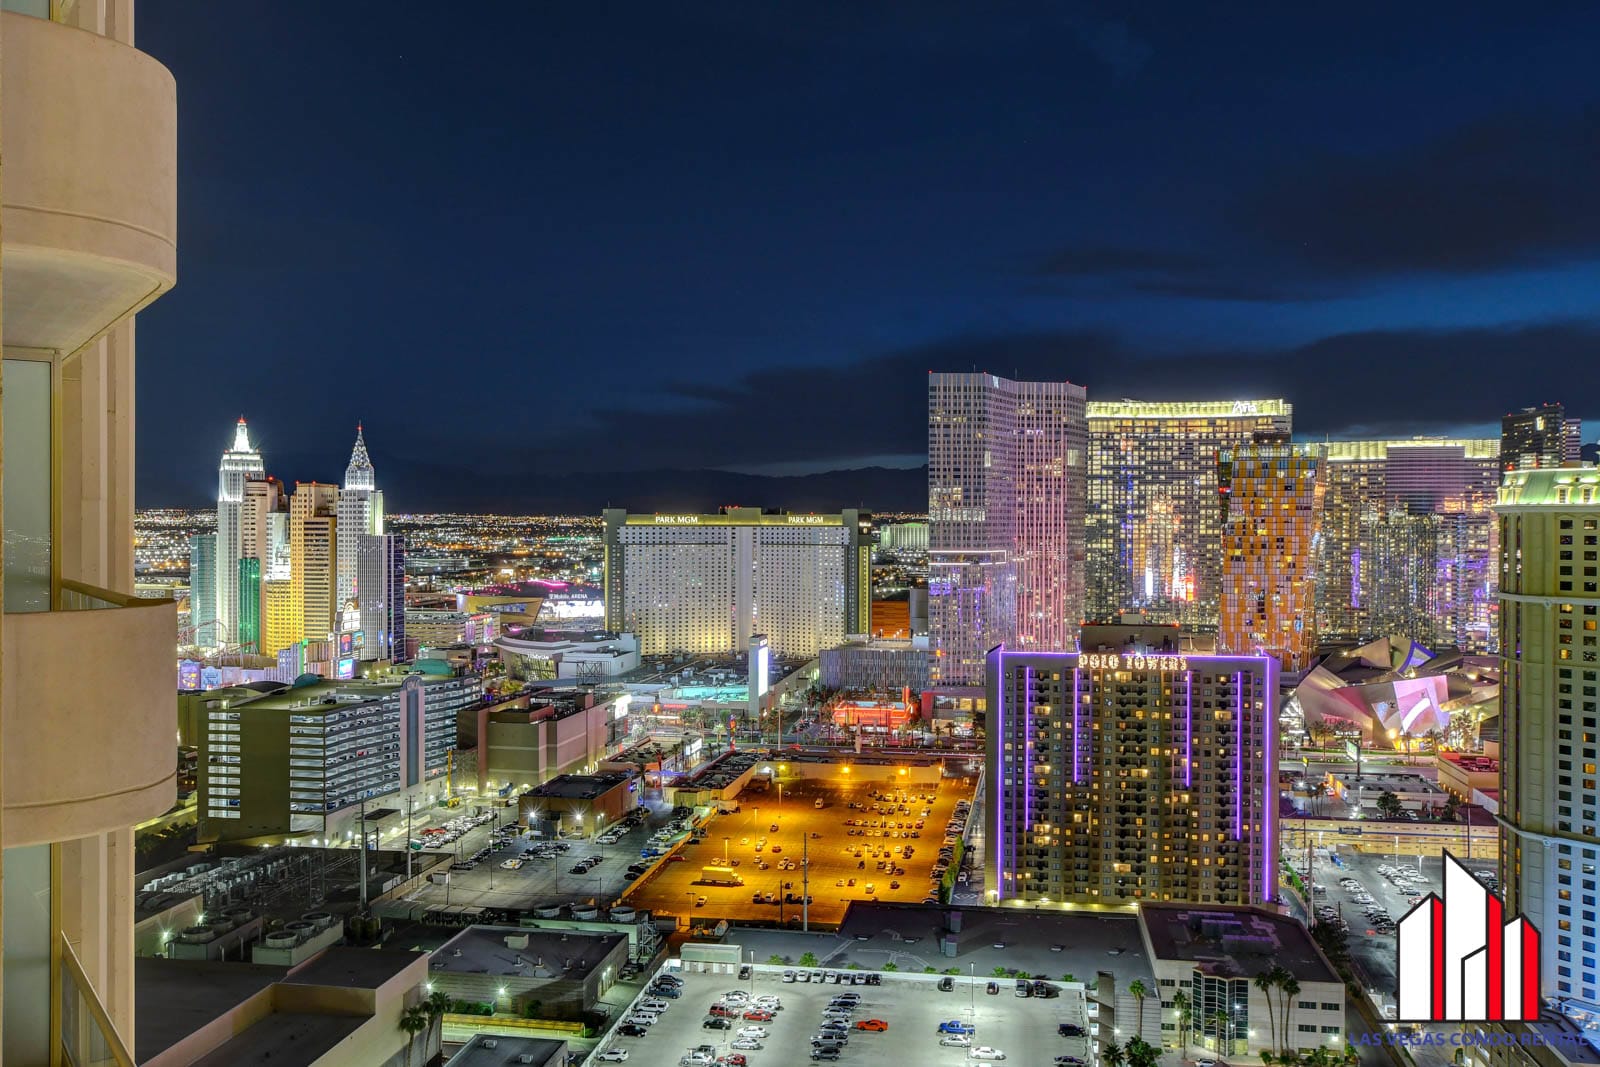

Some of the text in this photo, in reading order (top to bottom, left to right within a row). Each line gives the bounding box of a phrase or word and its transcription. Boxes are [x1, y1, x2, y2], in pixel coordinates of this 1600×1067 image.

[655, 516, 698, 524] PARK MGM
[788, 516, 824, 524] PARK MGM
[1078, 654, 1187, 671] POLO TOWERS
